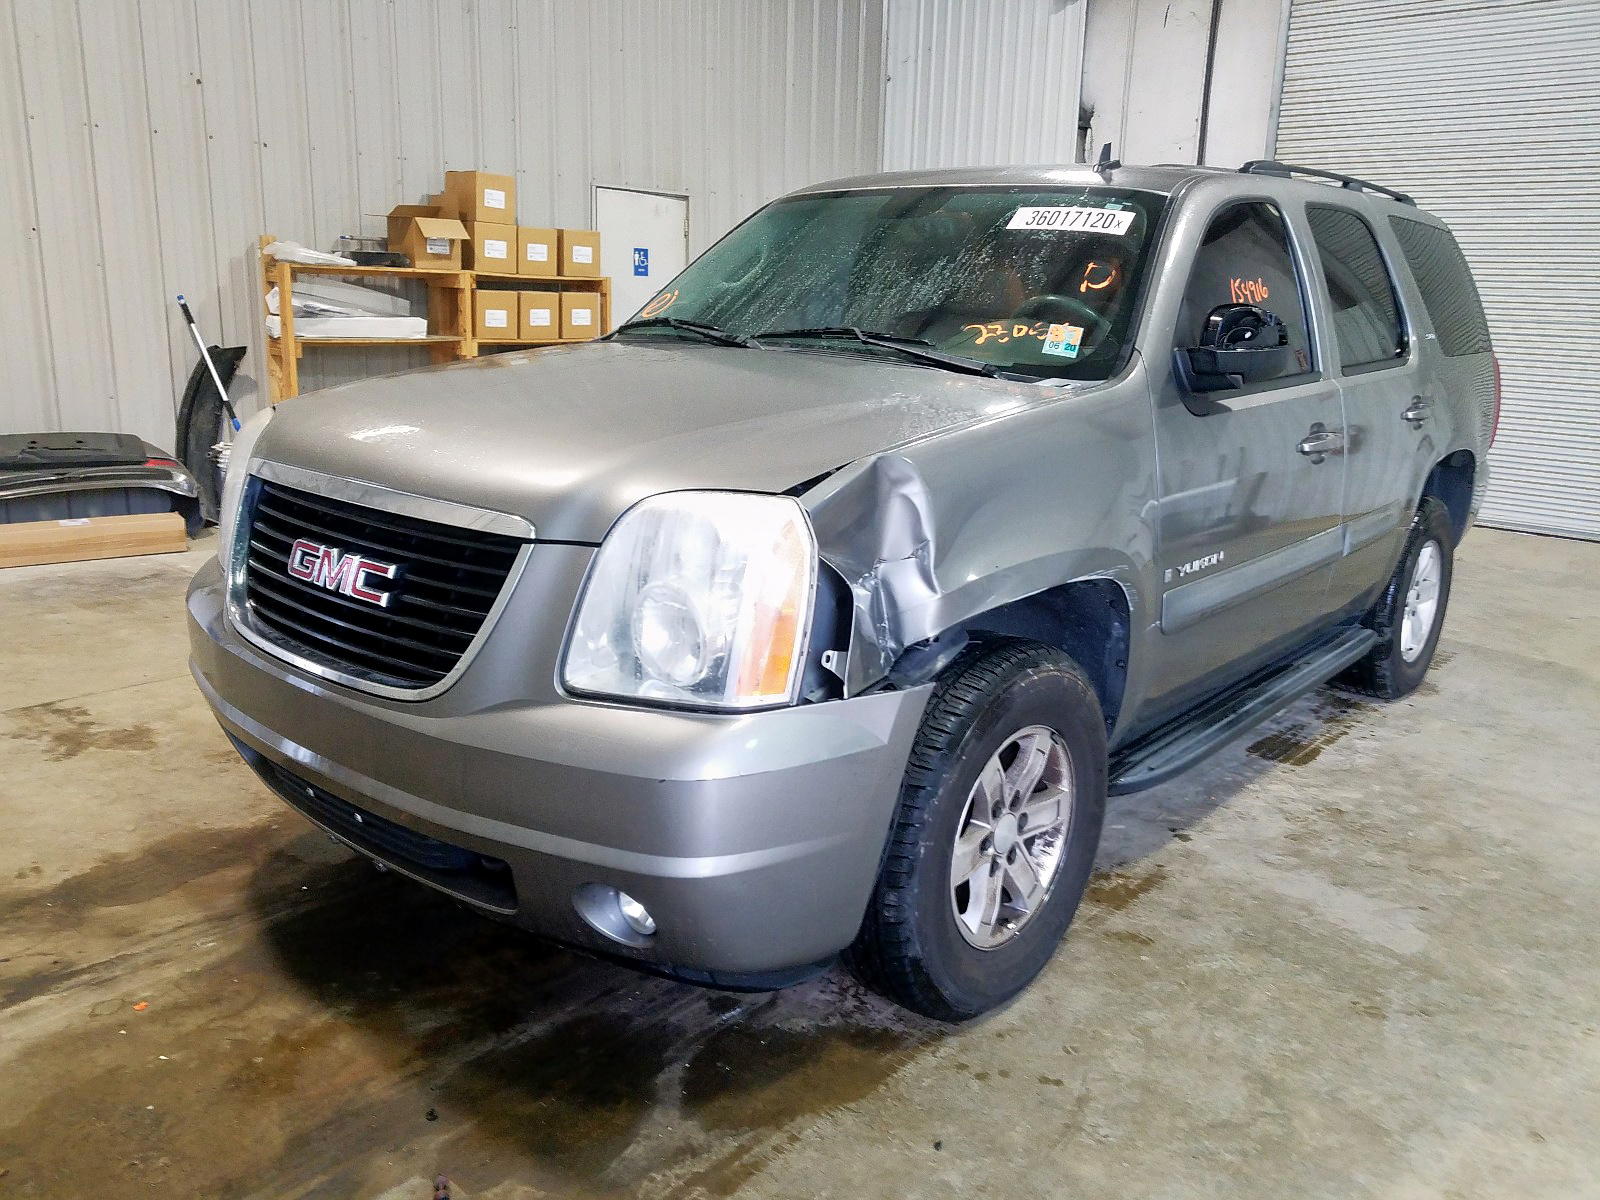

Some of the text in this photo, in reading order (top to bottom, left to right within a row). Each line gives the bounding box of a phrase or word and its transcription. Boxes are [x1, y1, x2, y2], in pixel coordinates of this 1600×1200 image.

[1048, 341, 1077, 352] 06 20
[287, 538, 397, 607] GMC
